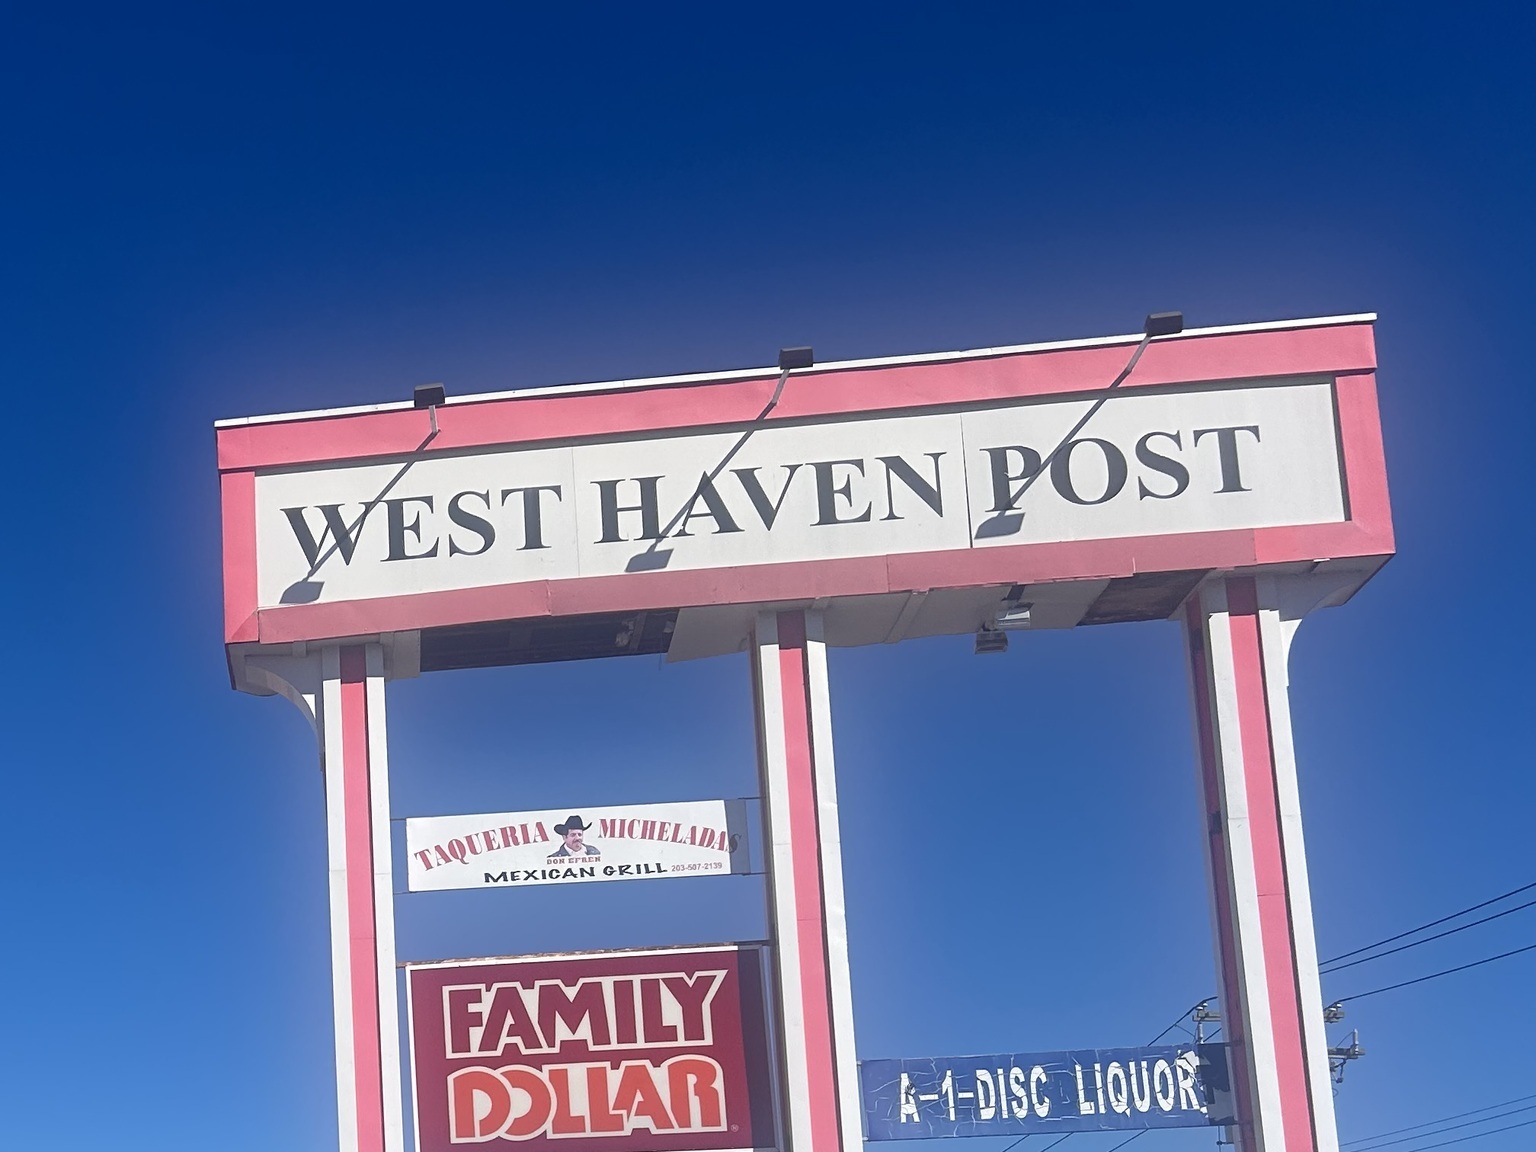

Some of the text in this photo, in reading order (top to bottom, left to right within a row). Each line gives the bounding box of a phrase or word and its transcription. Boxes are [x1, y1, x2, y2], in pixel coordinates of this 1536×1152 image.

[281, 425, 1261, 568] WEST HAVEN POST
[414, 818, 741, 871] TAQUERIA MICHELADAS
[484, 862, 723, 883] MEXICAN GRILL 203-507-2139
[442, 968, 729, 1059] FAMILY
[447, 1053, 727, 1144] DOLLAR
[900, 1065, 1051, 1124] A-1-DISC
